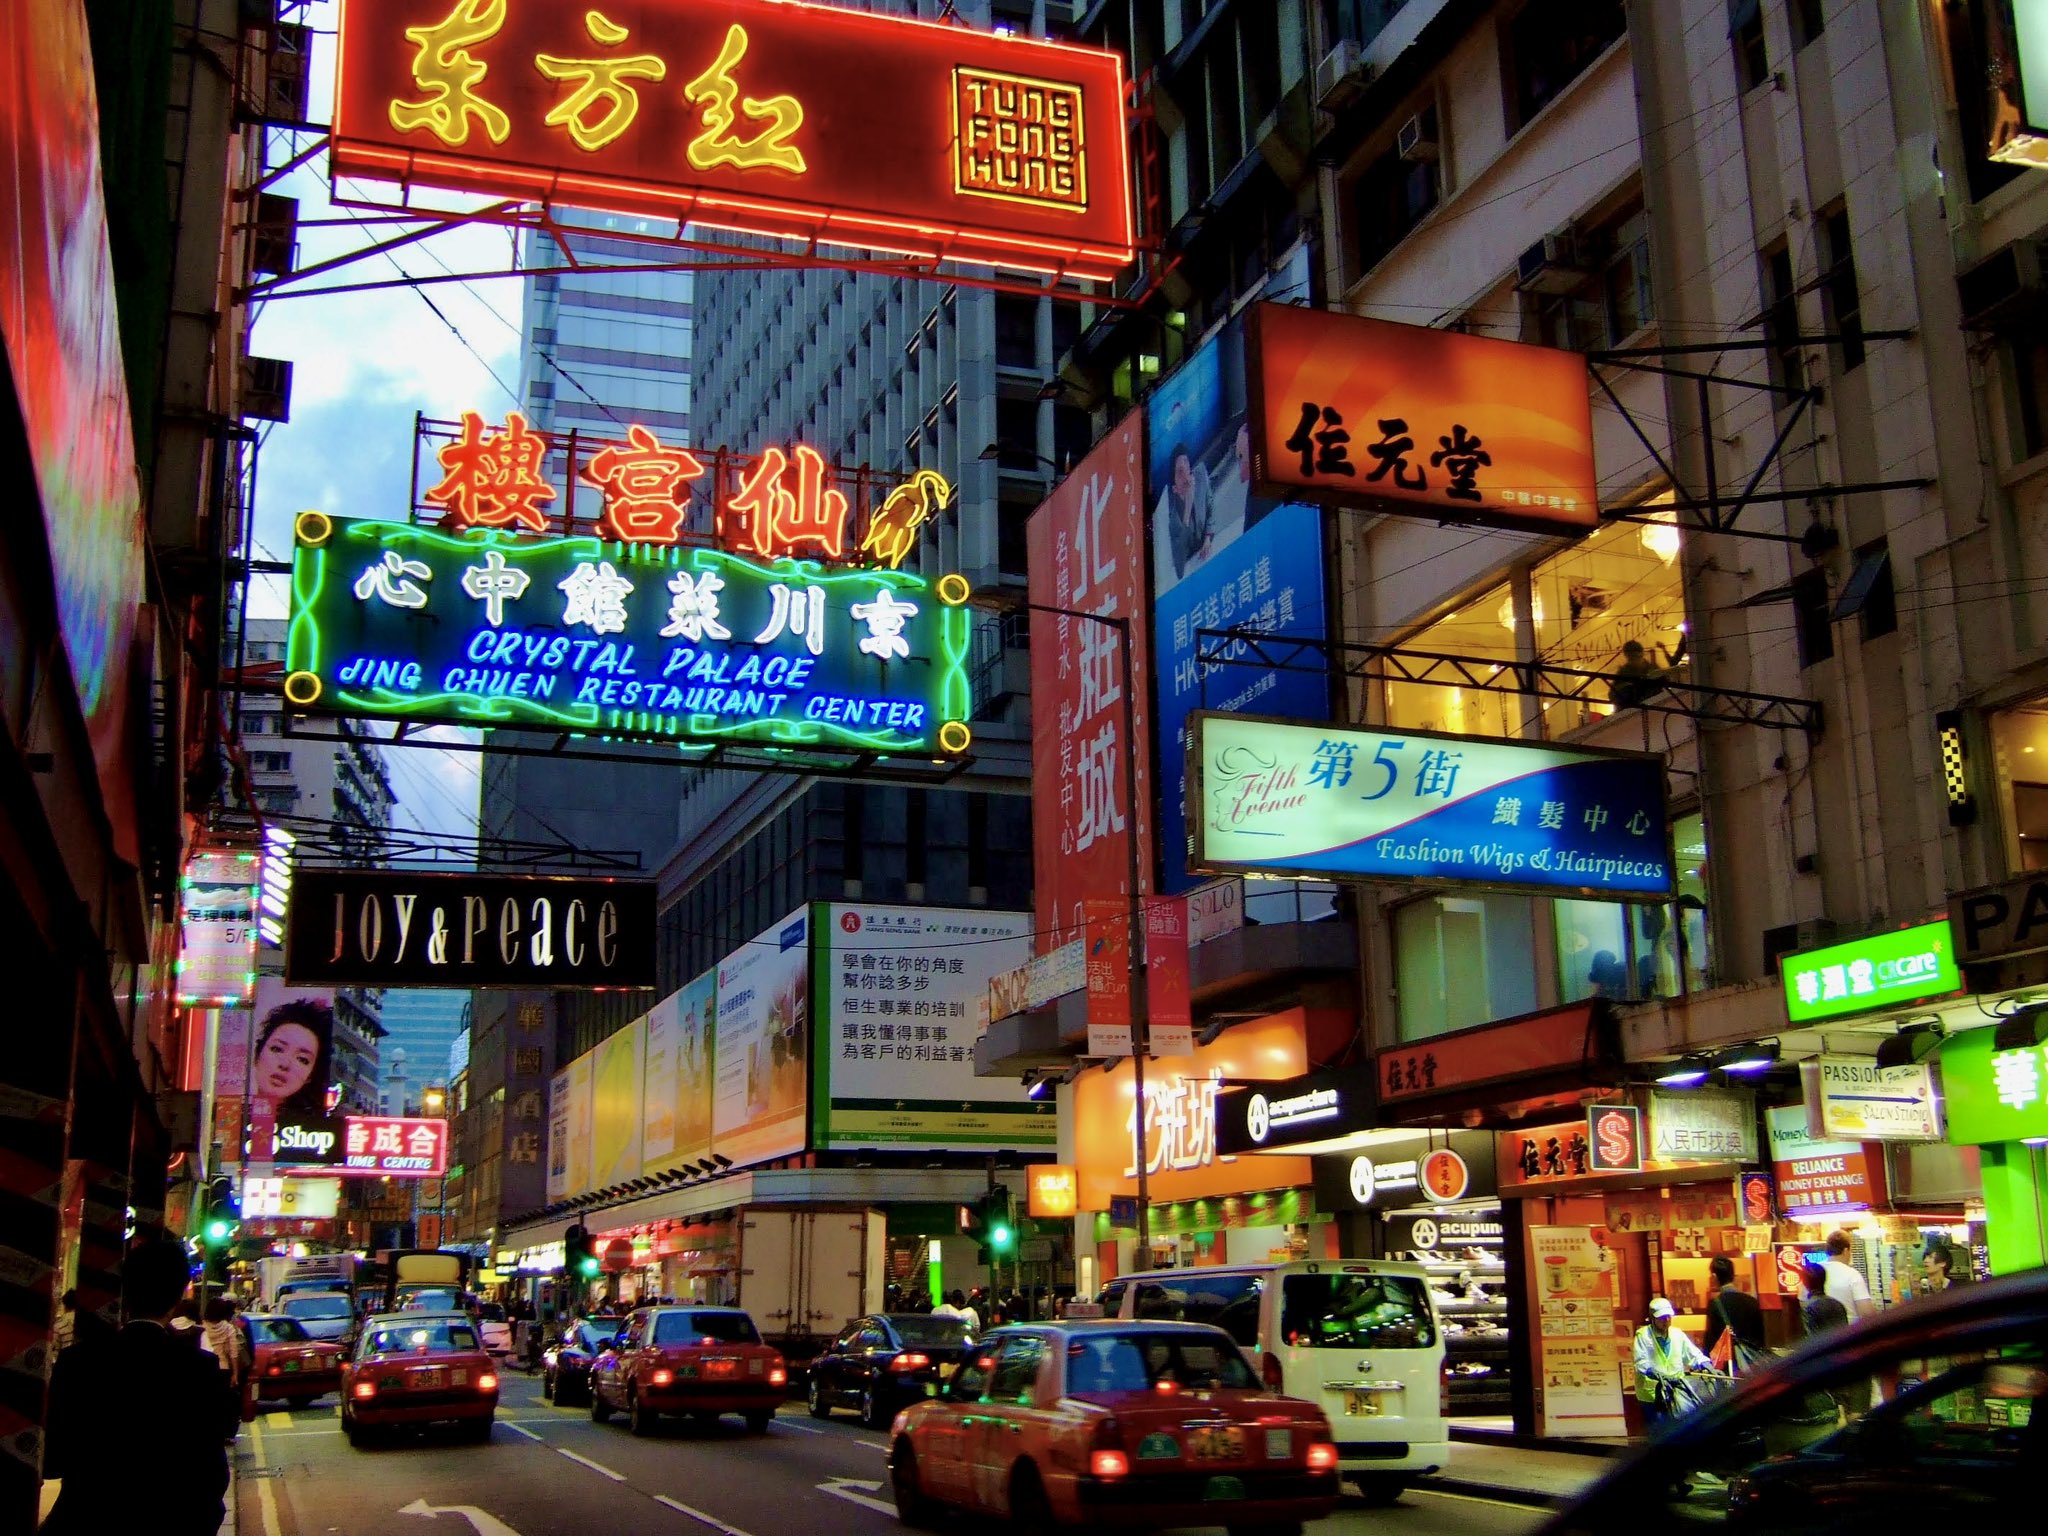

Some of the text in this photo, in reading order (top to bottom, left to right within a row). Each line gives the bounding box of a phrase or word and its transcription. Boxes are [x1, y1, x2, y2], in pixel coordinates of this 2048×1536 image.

[967, 81, 1072, 120] TUNG
[968, 116, 1076, 162] FONG
[970, 155, 1075, 197] HUNG
[467, 630, 815, 689] CRYSTAL PALACE
[340, 658, 924, 729] JING CHUEN RESTAURANT CENTER
[1239, 763, 1299, 800] Fifth
[1377, 837, 1663, 880] Fashion Wigs & Hairpieces
[843, 954, 964, 974] 學會在你的角度
[843, 974, 929, 991] 幫你諗多步
[843, 999, 965, 1018] 恒生專業的培訓
[1824, 1066, 1882, 1083] PASSION
[1991, 1050, 2048, 1110] 華
[281, 1125, 334, 1154] Shop
[383, 1156, 433, 1169] CENTRE
[1792, 1158, 1845, 1176] RELIANCE
[1781, 1174, 1864, 1191] MONEY EXCHANGE
[1440, 1222, 1503, 1238] acupun
